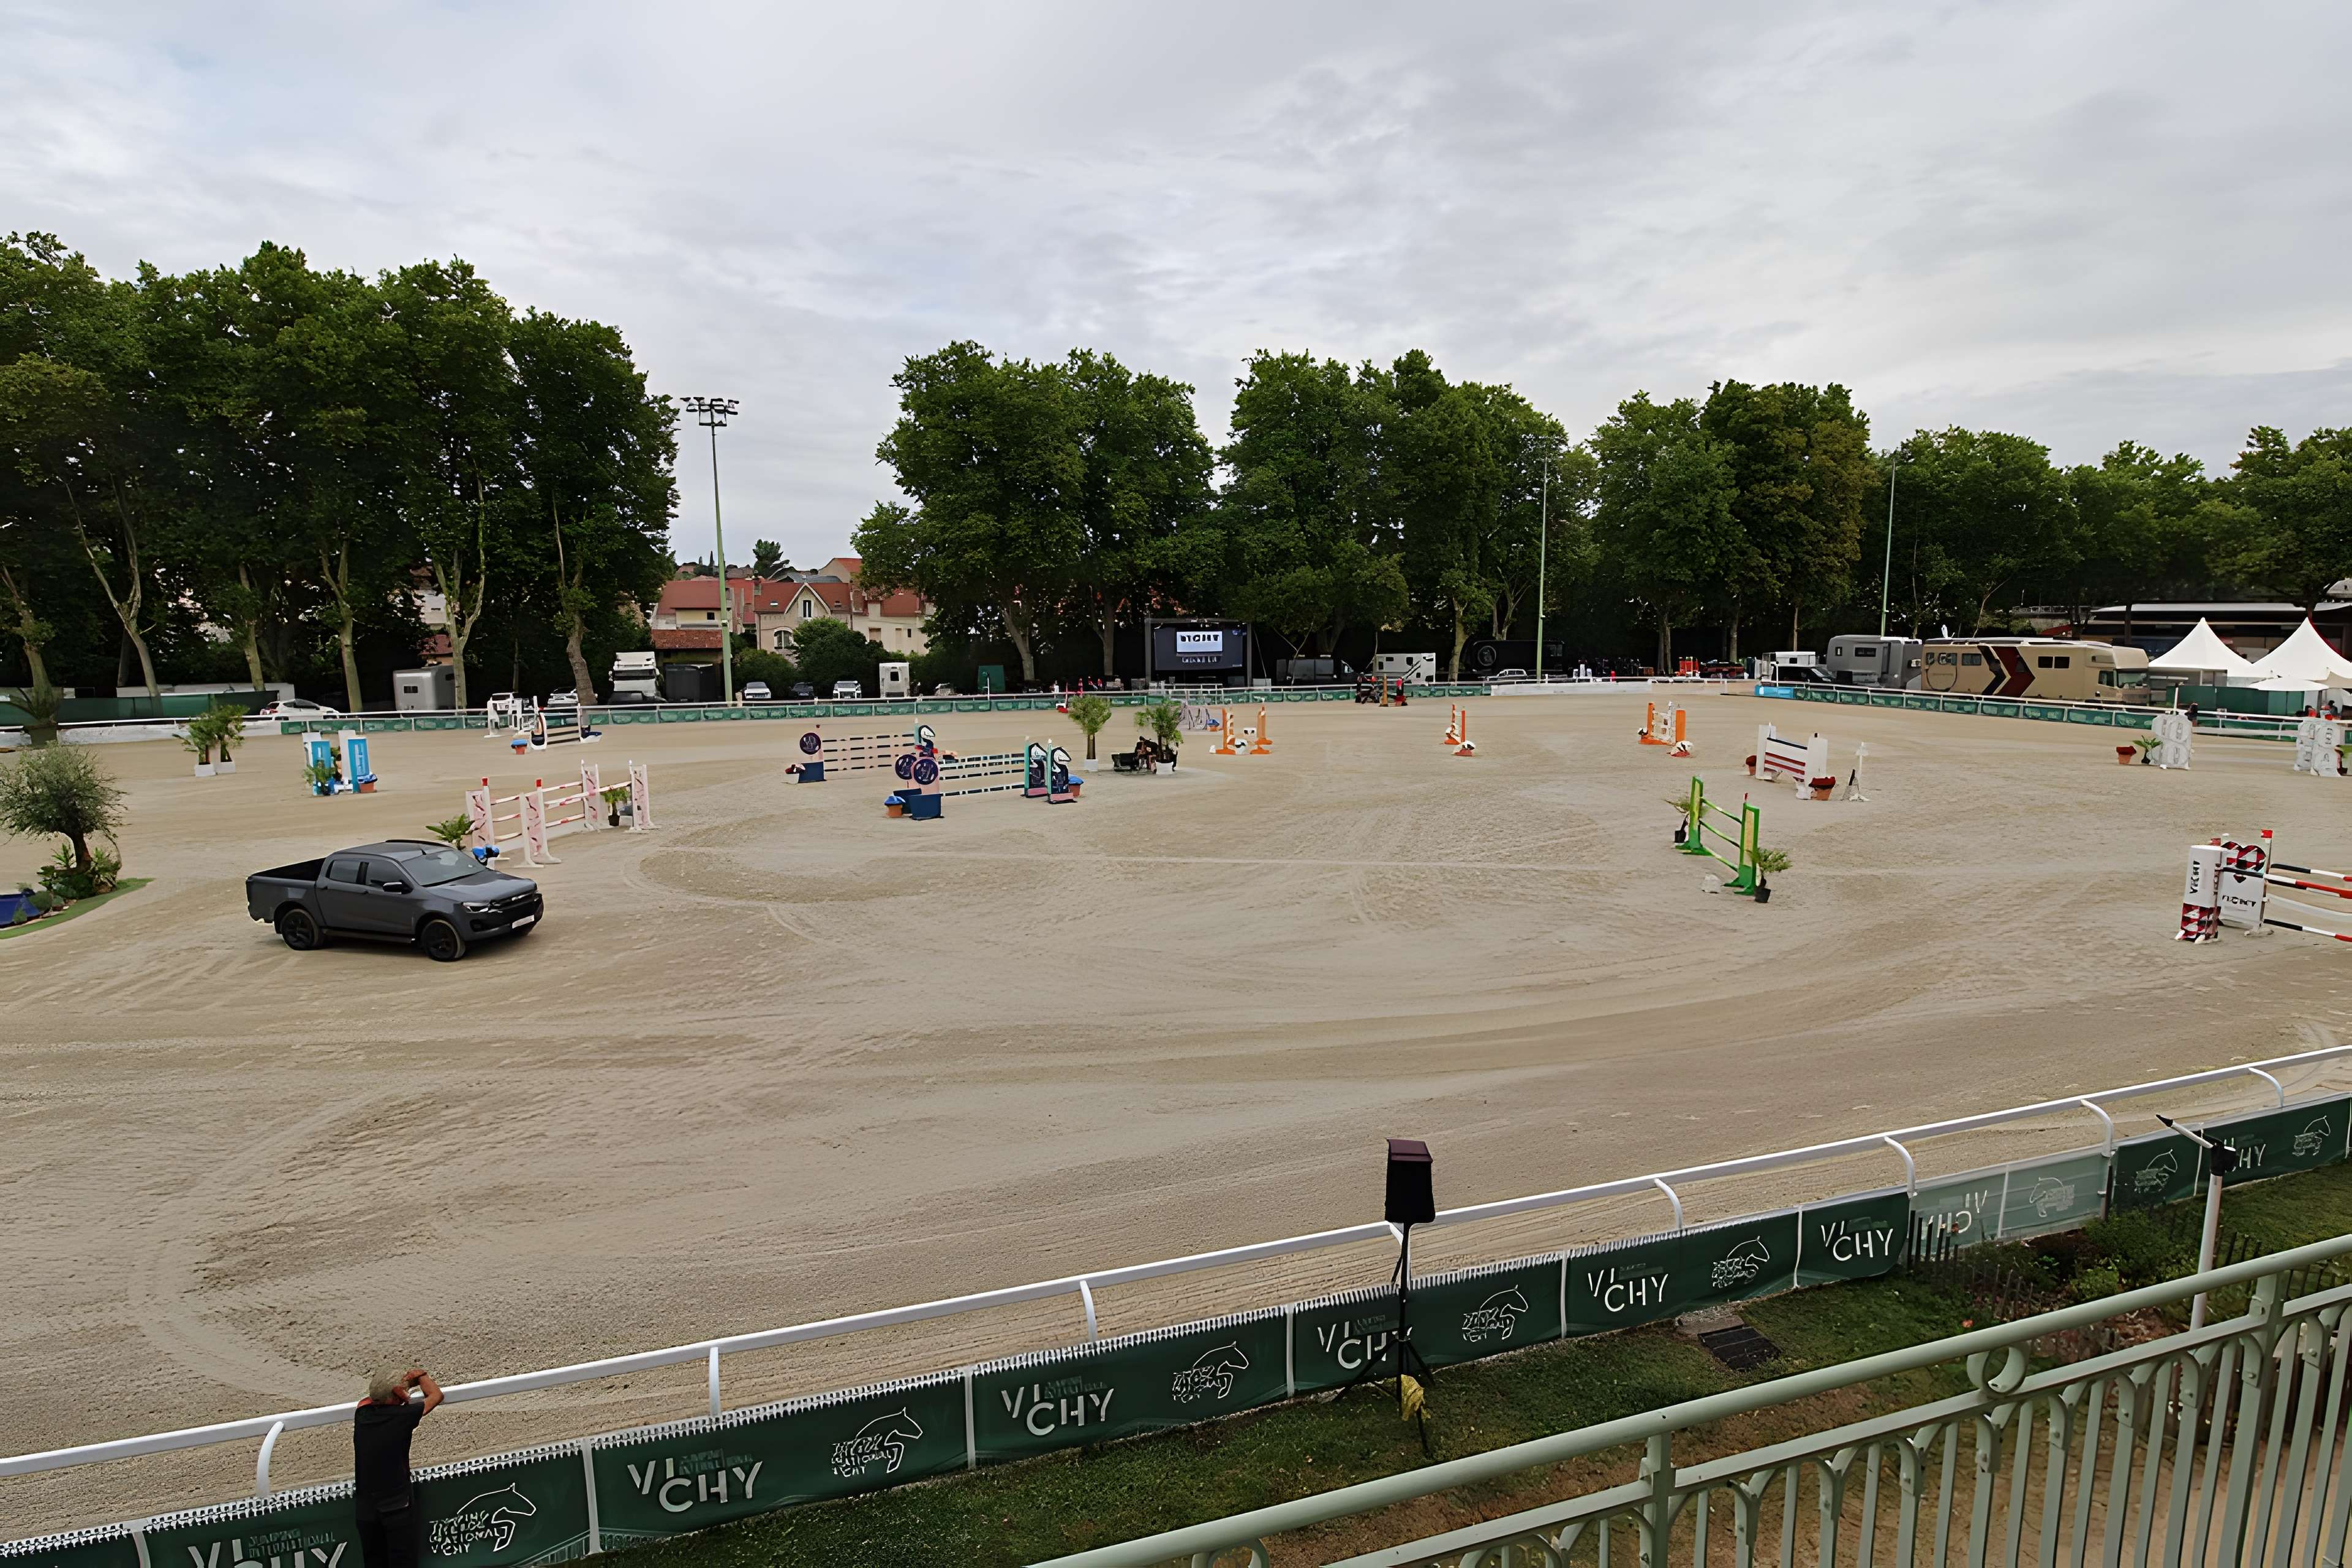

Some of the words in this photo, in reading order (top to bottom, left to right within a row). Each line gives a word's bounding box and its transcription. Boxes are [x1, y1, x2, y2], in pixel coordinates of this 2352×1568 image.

[1820, 1220, 1894, 1262] VICHY
[1588, 1267, 1669, 1313] VICHY
[1000, 1383, 1115, 1436] VICHY
[627, 1457, 763, 1513] VICHY
